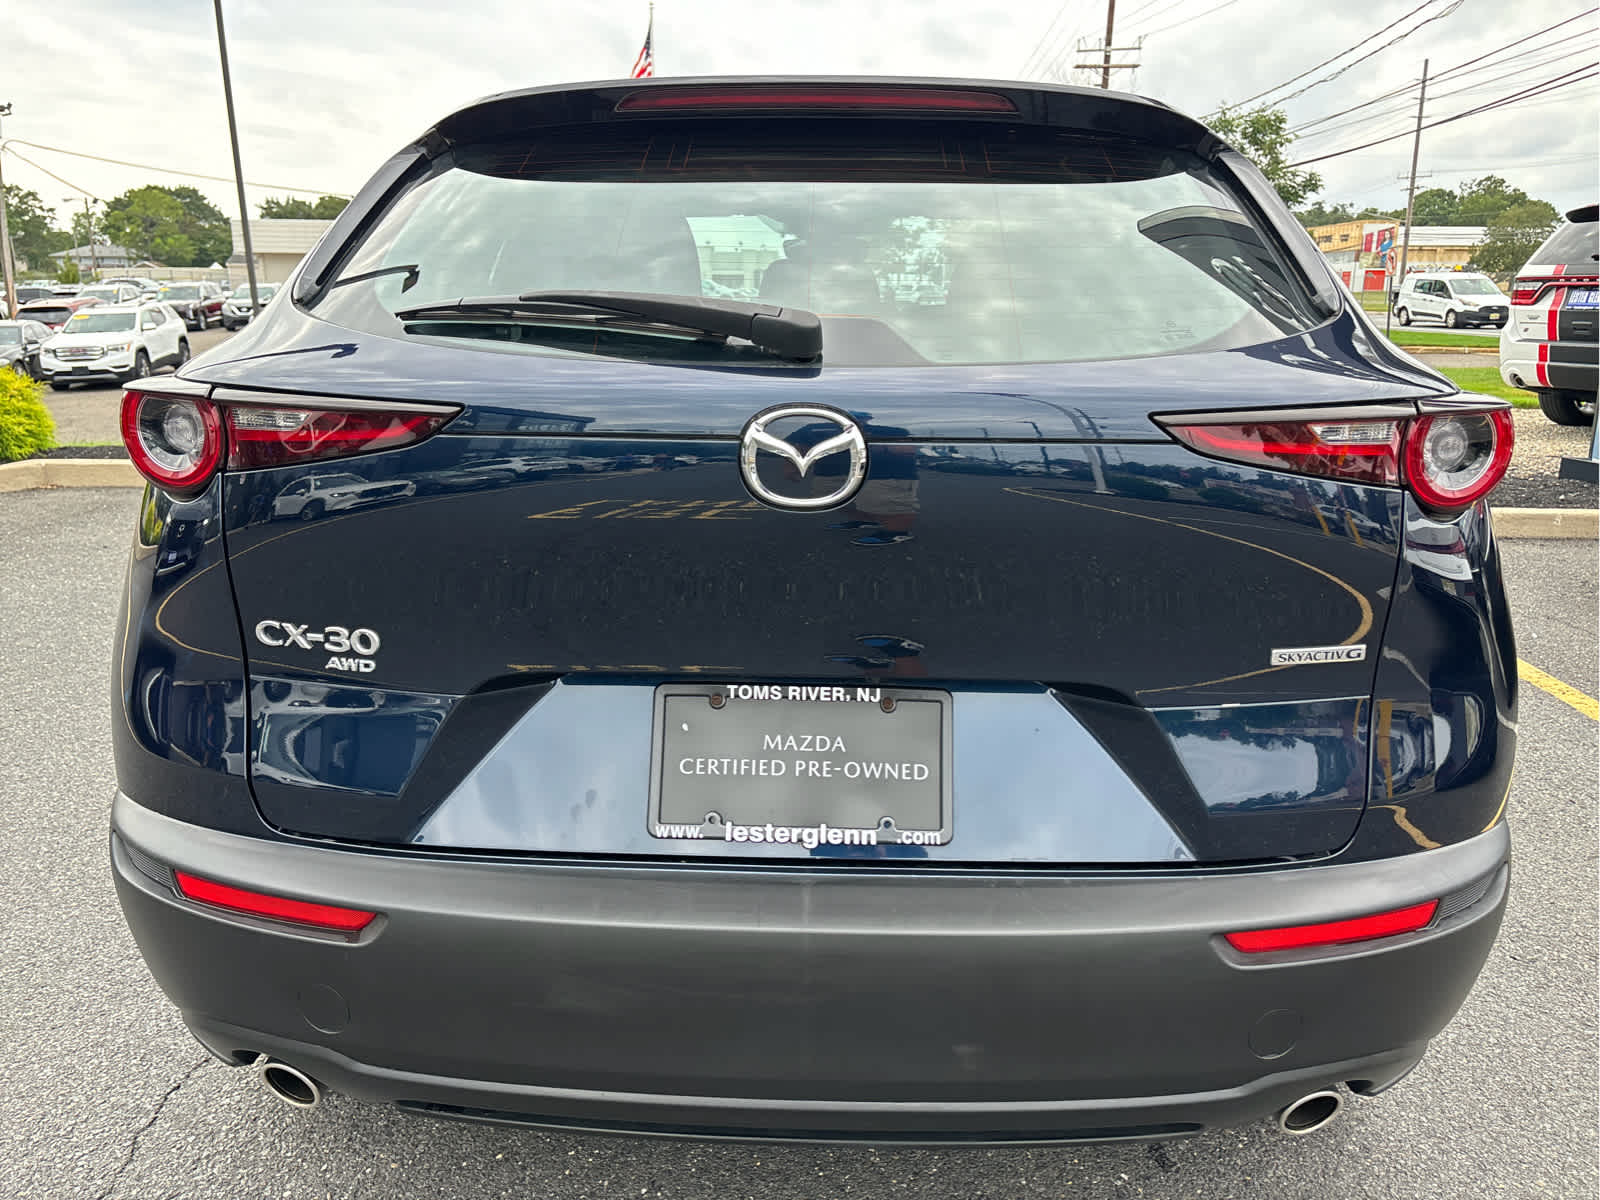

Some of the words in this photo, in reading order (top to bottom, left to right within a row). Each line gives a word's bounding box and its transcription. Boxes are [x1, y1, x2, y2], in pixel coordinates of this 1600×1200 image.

[255, 619, 380, 656] CX-30
[325, 656, 376, 673] AWD
[727, 684, 782, 700] TOMS
[788, 686, 851, 702] RIVER,
[856, 687, 881, 703] NJ
[763, 734, 846, 753] MAZDA
[679, 758, 786, 778] CERTIFIED
[795, 760, 929, 781] PRE-OWNED
[655, 824, 704, 839] www.
[725, 821, 877, 848] lesterglenn
[896, 830, 941, 845] .com
